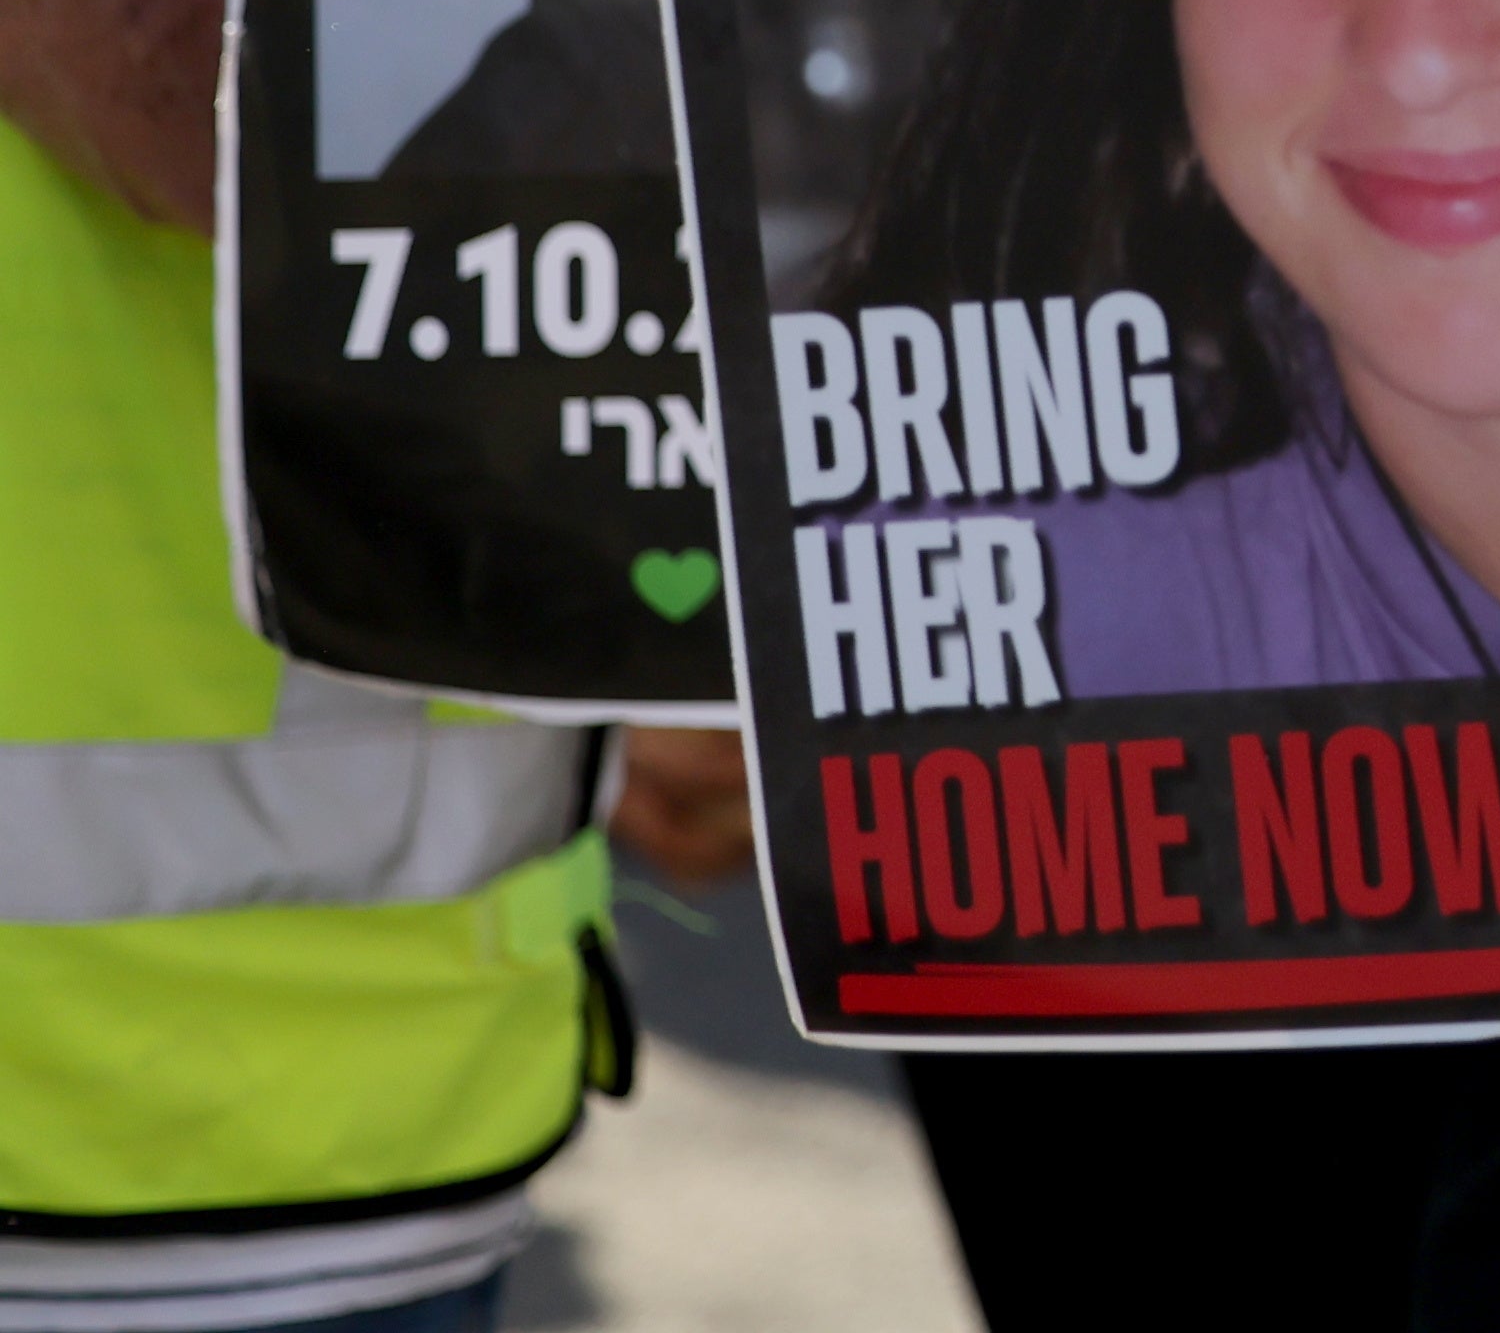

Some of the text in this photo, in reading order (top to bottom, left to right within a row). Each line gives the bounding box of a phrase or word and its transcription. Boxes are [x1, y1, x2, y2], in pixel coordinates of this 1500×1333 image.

[769, 290, 1182, 508] BRING
[794, 515, 1062, 720] HER
[820, 737, 1199, 945] HOME
